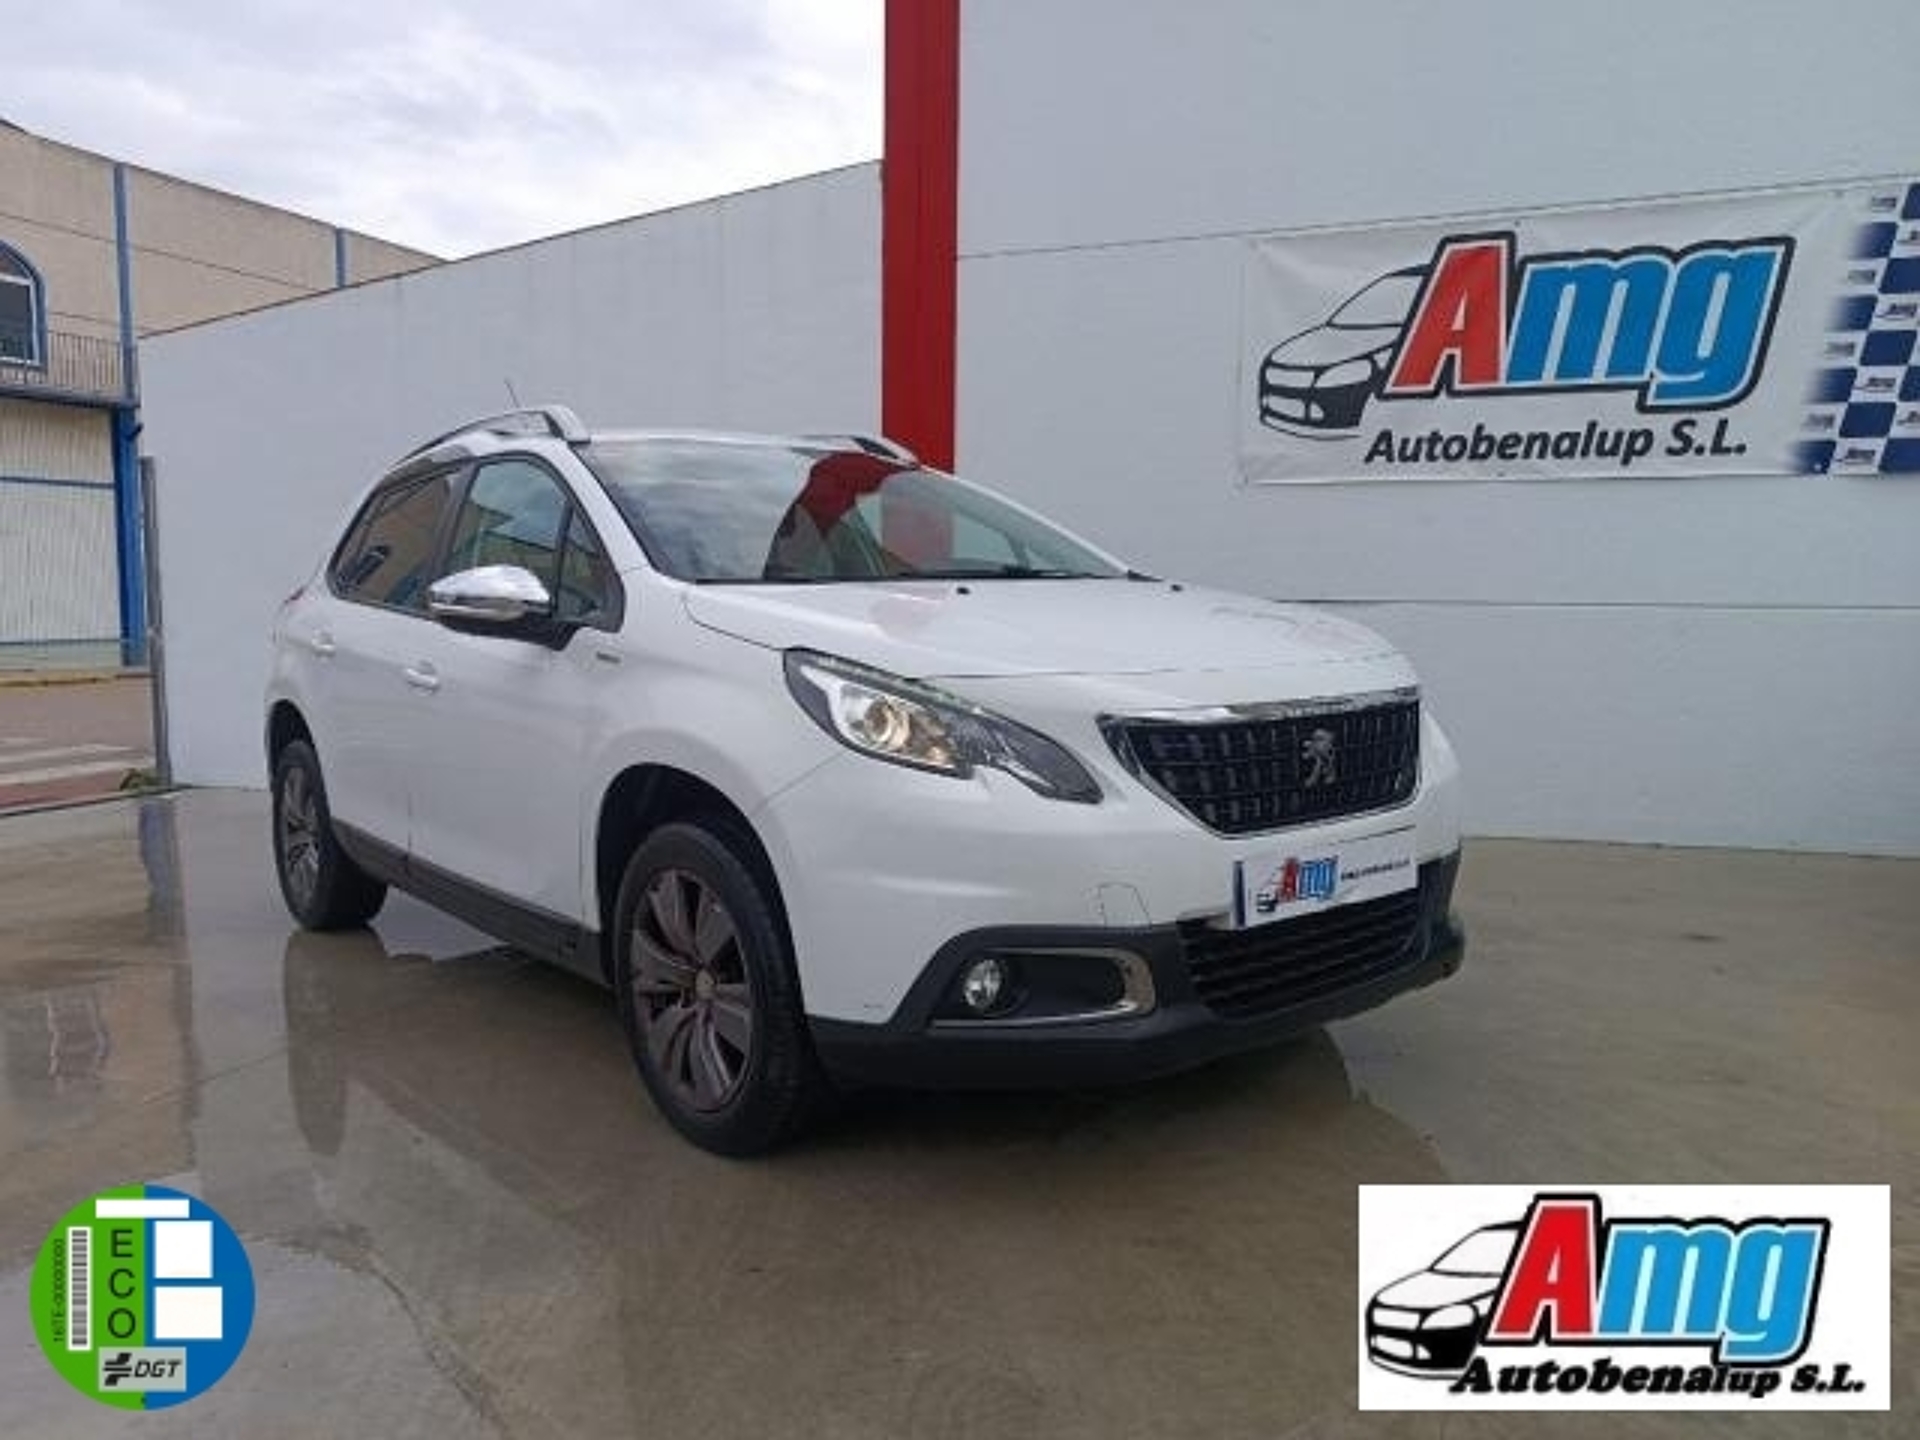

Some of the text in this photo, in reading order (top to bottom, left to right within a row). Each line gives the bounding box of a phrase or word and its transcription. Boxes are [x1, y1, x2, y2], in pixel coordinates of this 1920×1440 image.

[1378, 231, 1795, 414] Amg
[1364, 418, 1747, 467] Autobenalup S.L.
